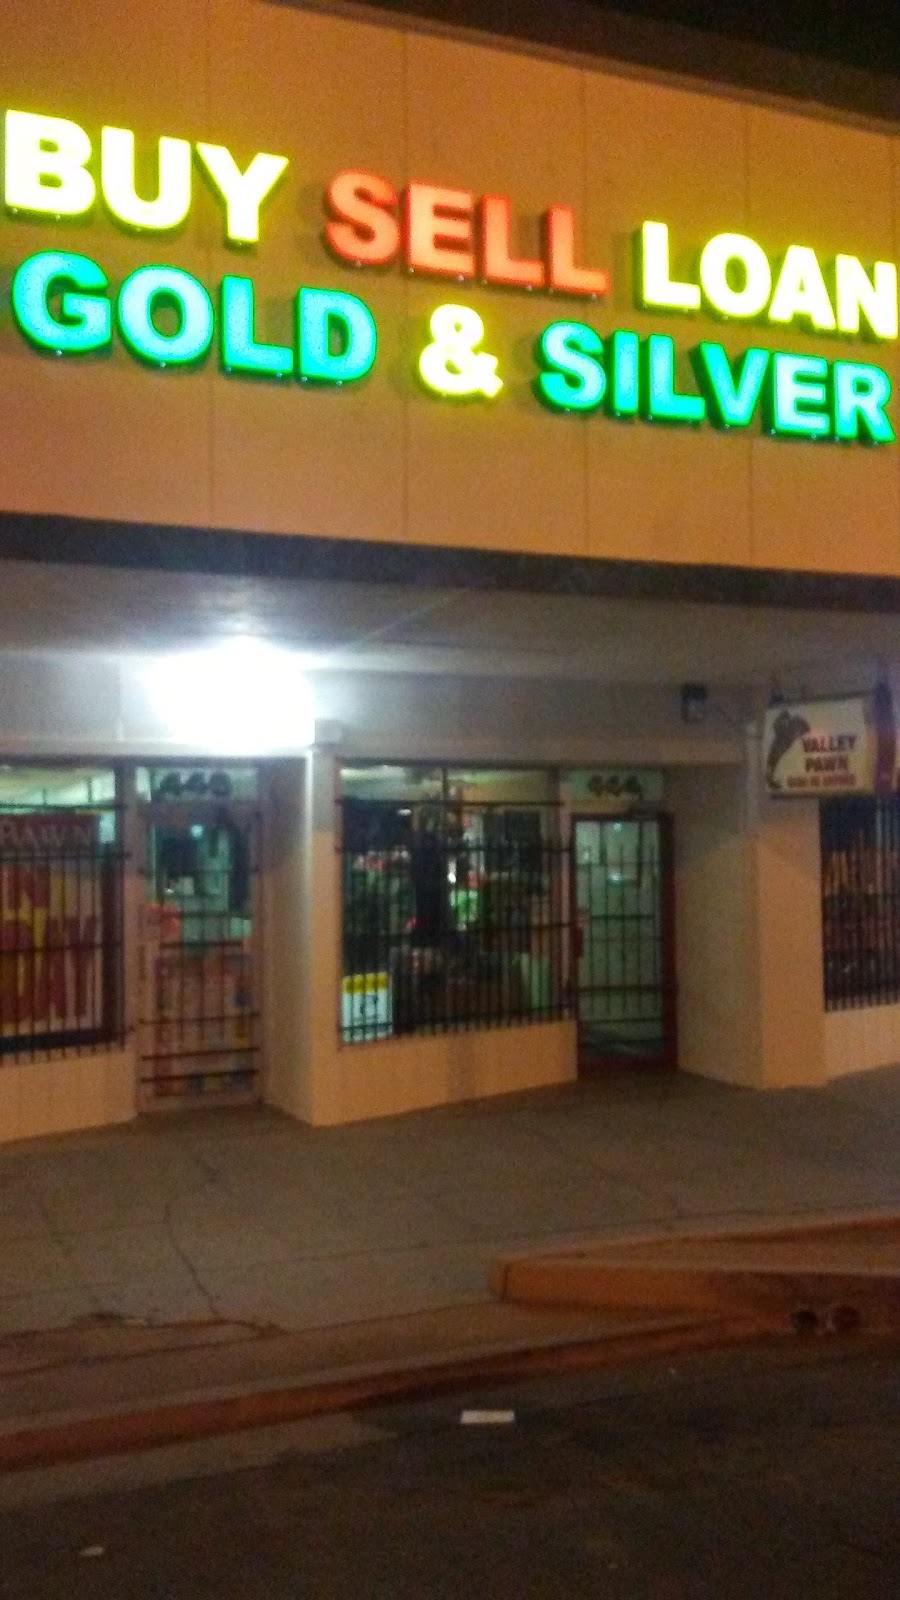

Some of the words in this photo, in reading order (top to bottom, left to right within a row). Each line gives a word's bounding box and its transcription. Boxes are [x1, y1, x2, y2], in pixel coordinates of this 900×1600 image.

[3, 108, 290, 245] BUY
[325, 170, 609, 299] SELL
[638, 219, 900, 342] LOAN
[12, 249, 378, 385] GOLD
[418, 303, 504, 398] &
[535, 320, 895, 444] SILVER
[802, 735, 857, 752] VALLEY
[805, 756, 848, 773] PAWN
